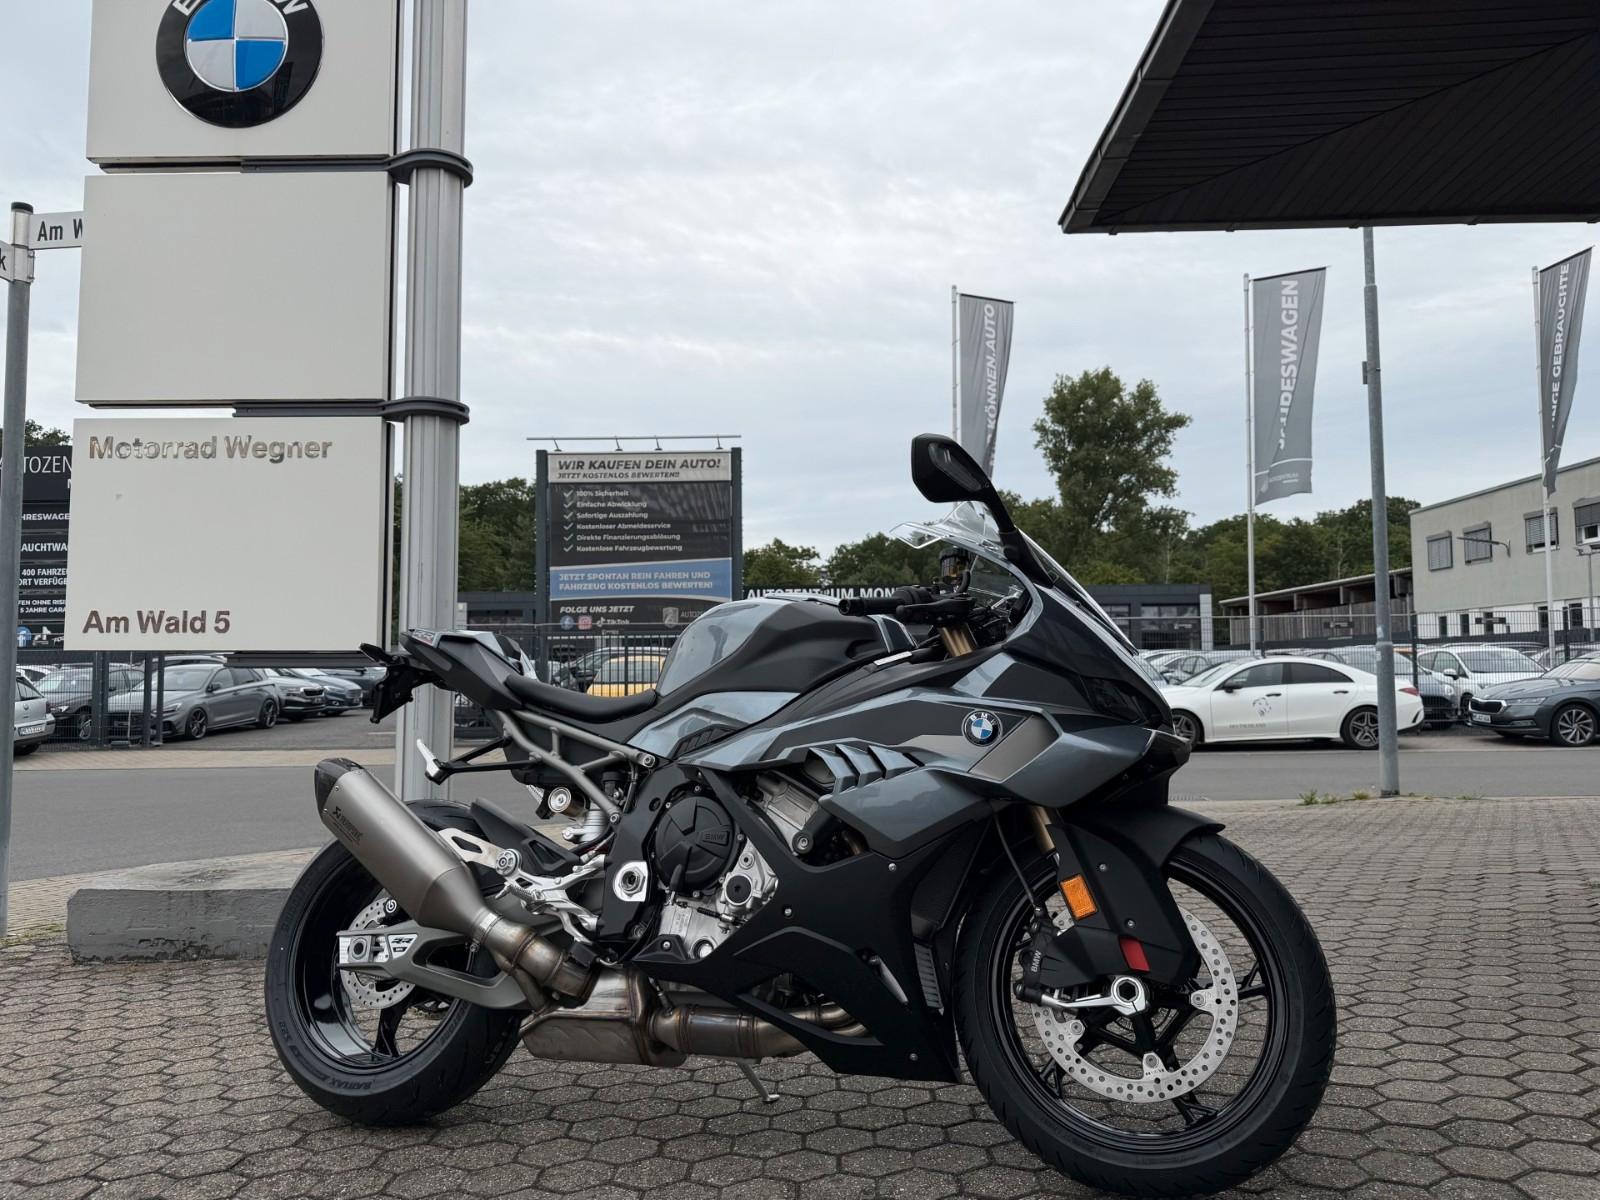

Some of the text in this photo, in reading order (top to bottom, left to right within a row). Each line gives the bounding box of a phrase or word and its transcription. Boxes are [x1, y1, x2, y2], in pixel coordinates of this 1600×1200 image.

[37, 220, 63, 241] Am
[1552, 263, 1570, 377] GEBRAUCHTE
[89, 435, 333, 464] Motorrad Wegner
[0, 456, 72, 473] TOZEN
[558, 458, 721, 470] WIR KAUFEN DEIN AUTO!
[607, 501, 647, 509] Abwicklung
[576, 512, 648, 520] Sofortige Auszahlung
[603, 533, 681, 541] Finanzierungsablösung
[615, 544, 683, 552] Fahrzeugbewertung
[22, 568, 67, 576] 400 FAHRZE
[691, 571, 711, 579] UND
[559, 581, 713, 591] FAHRZEUG KOSTENLOS BEWERTEN!
[608, 605, 636, 613] JETZT
[82, 610, 230, 634] Am Wald 5
[1031, 950, 1041, 972] BMW
